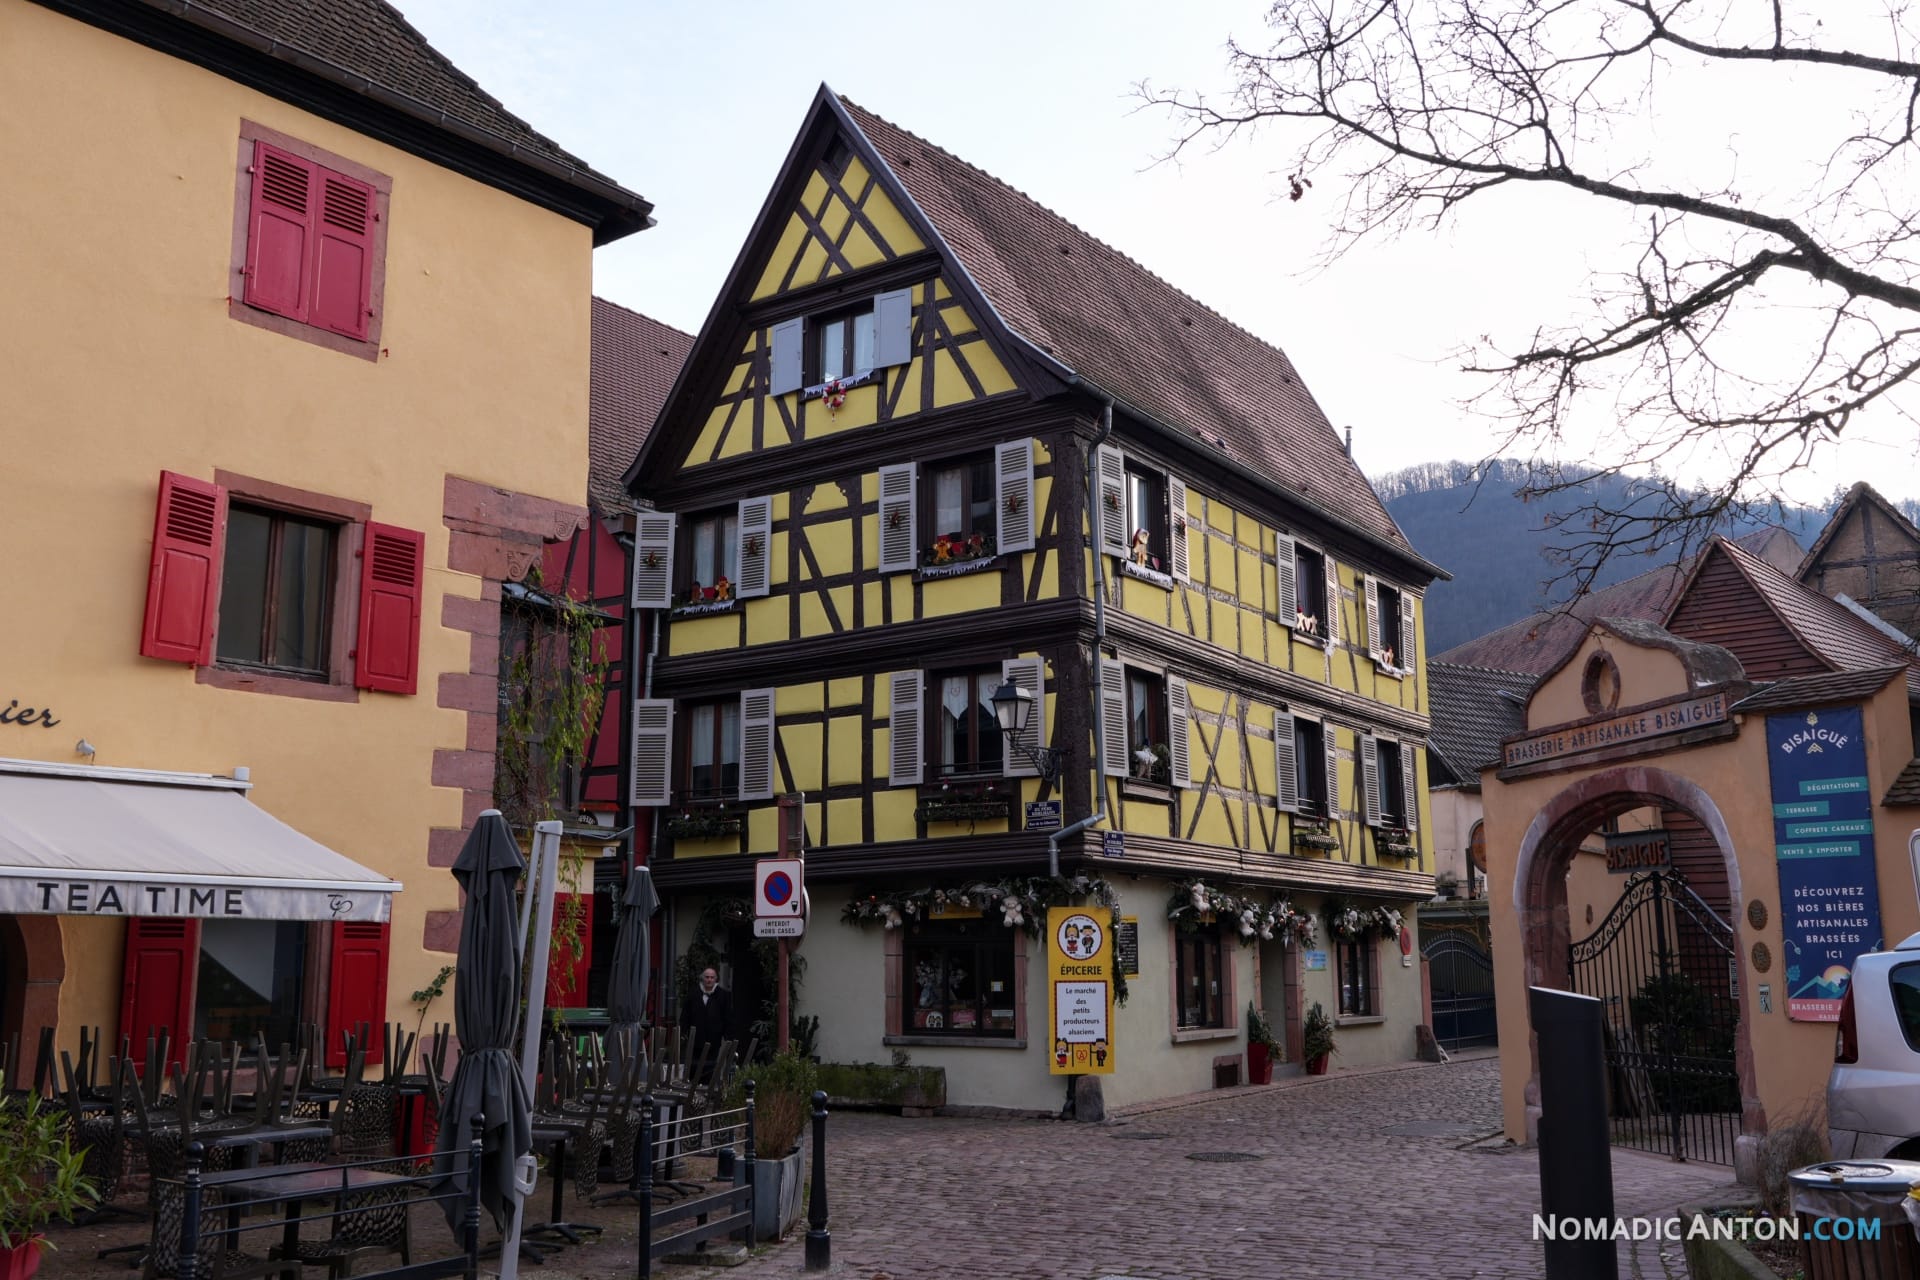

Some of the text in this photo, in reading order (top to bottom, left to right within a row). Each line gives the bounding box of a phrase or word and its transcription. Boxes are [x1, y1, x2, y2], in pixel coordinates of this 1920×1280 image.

[1508, 696, 1721, 763] BRASSERIE ARTISANALE BISAIGUË
[1781, 728, 1849, 754] BISAIGUË
[1807, 782, 1860, 792] DÉGUSTATIONS
[1786, 806, 1818, 814] TERRASSE
[1794, 824, 1865, 834] COFFRETS CADEAUX
[1816, 846, 1853, 854] EMPORTER
[1794, 886, 1864, 897] DÉCOUVREZ
[37, 882, 243, 915] TEA TIME
[1797, 901, 1864, 912] NOS BIÈRES
[1796, 919, 1868, 928] ARTISANALES
[1806, 932, 1860, 943] BRASSÉES
[1826, 950, 1843, 959] ICI
[1060, 963, 1103, 976] ÉPICERIE
[1791, 1003, 1833, 1011] BRASSERIE
[1063, 1017, 1100, 1026] producteurs
